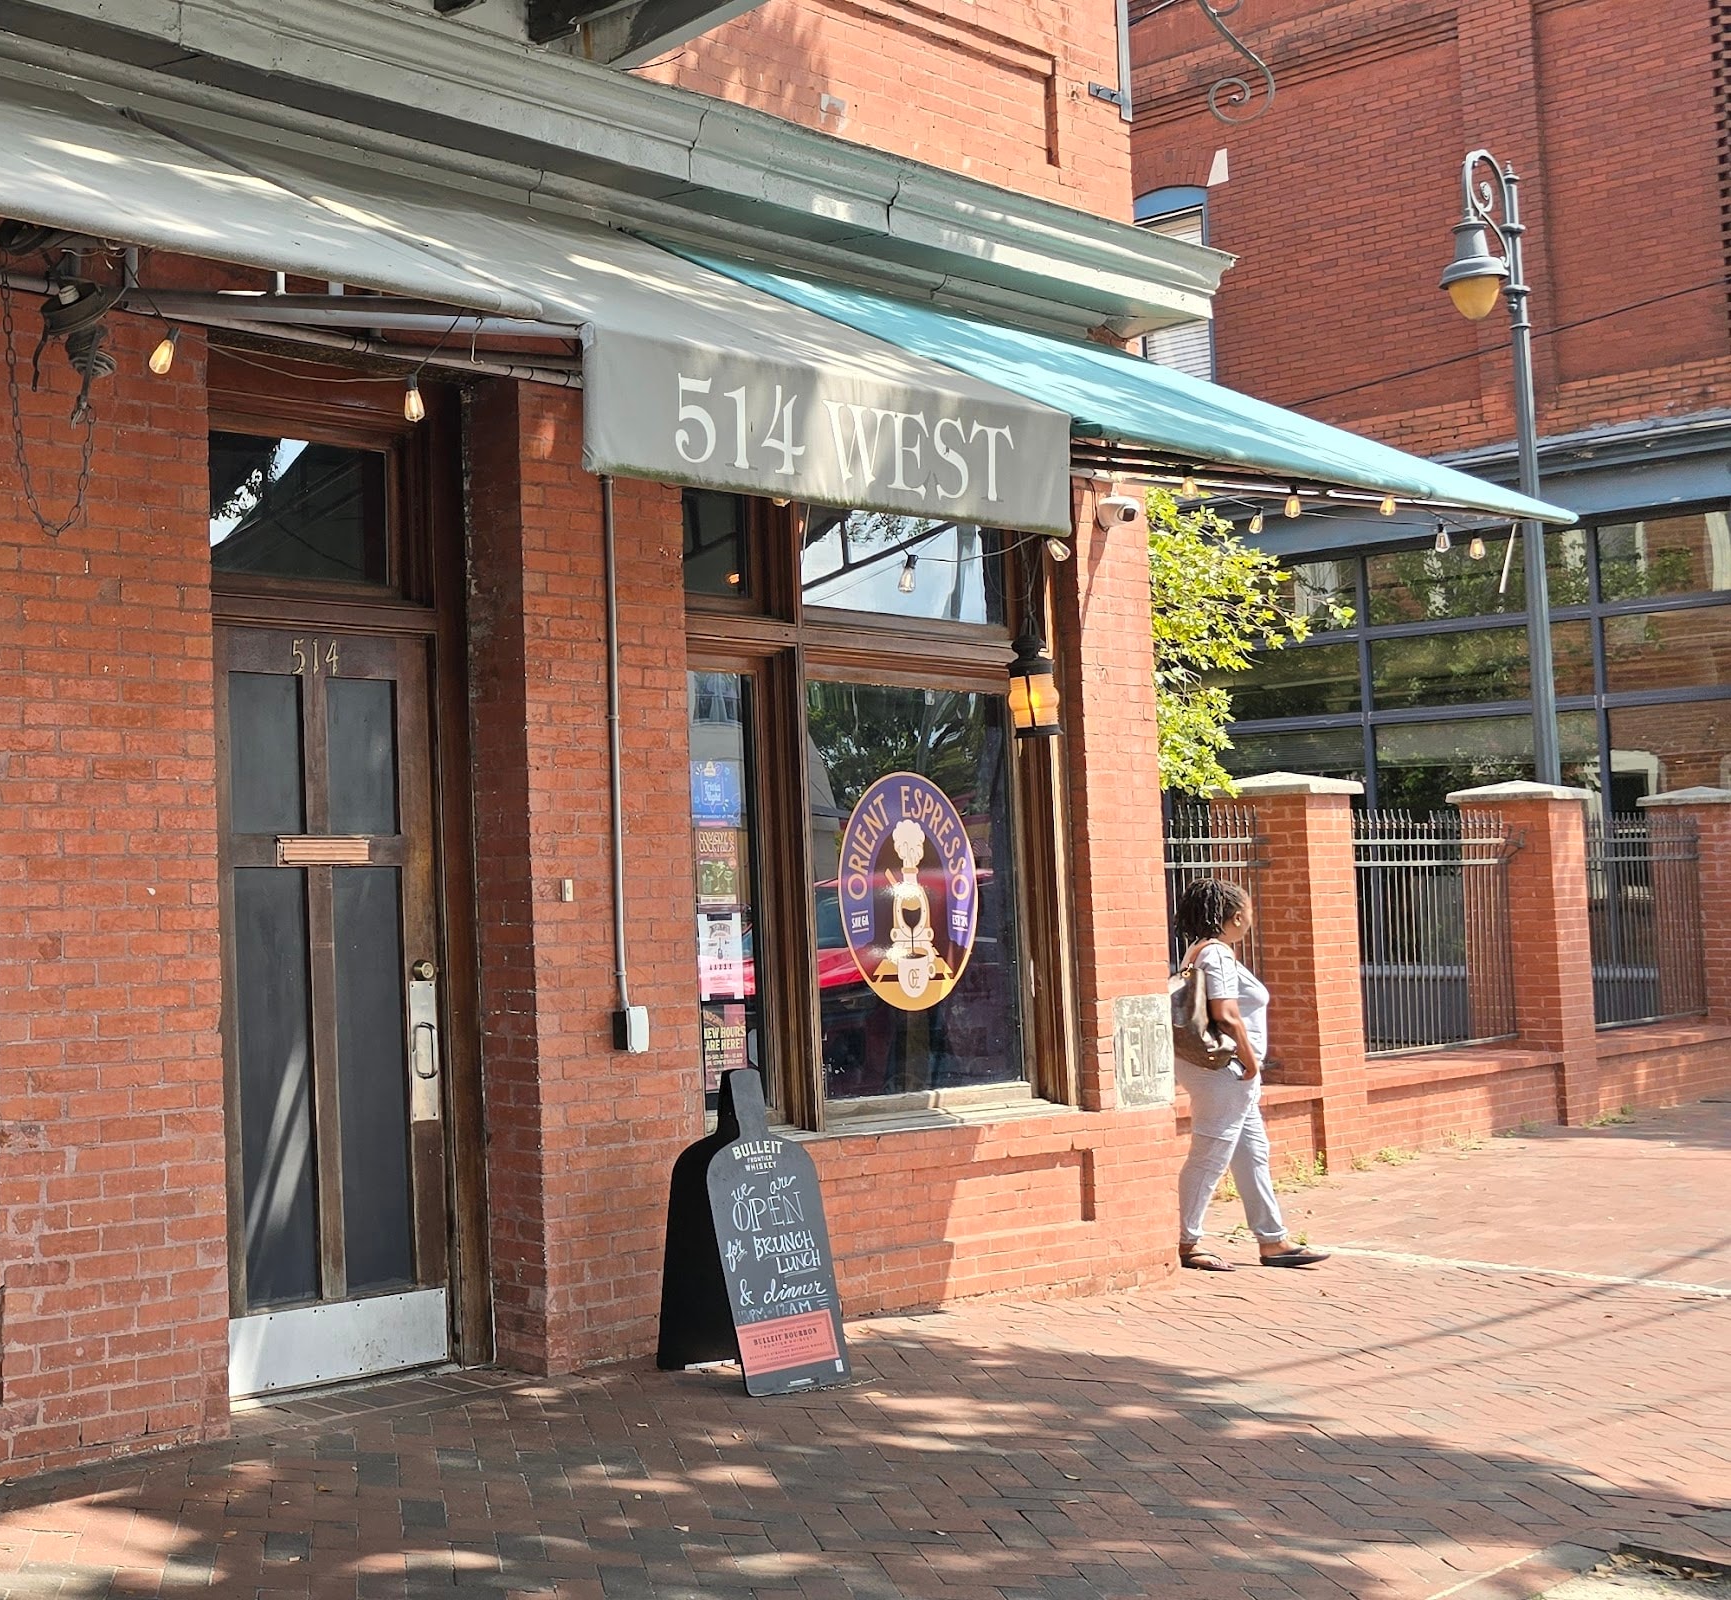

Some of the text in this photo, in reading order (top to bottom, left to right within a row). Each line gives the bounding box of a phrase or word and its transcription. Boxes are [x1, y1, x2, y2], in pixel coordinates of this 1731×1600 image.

[675, 372, 1015, 502] 514 WEST
[291, 638, 339, 676] 514
[847, 785, 970, 901] ORIENT ESPRESSO
[720, 1026, 746, 1039] HOURS
[721, 1039, 744, 1051] HERE!
[732, 1140, 783, 1160] BULLEIT
[744, 1161, 777, 1172] WHISKEY
[769, 1175, 797, 1195] are
[732, 1191, 805, 1232] OPEN
[725, 1230, 815, 1273] for BRUNCH
[776, 1249, 821, 1269] LUNCH
[739, 1278, 827, 1306] & dinner
